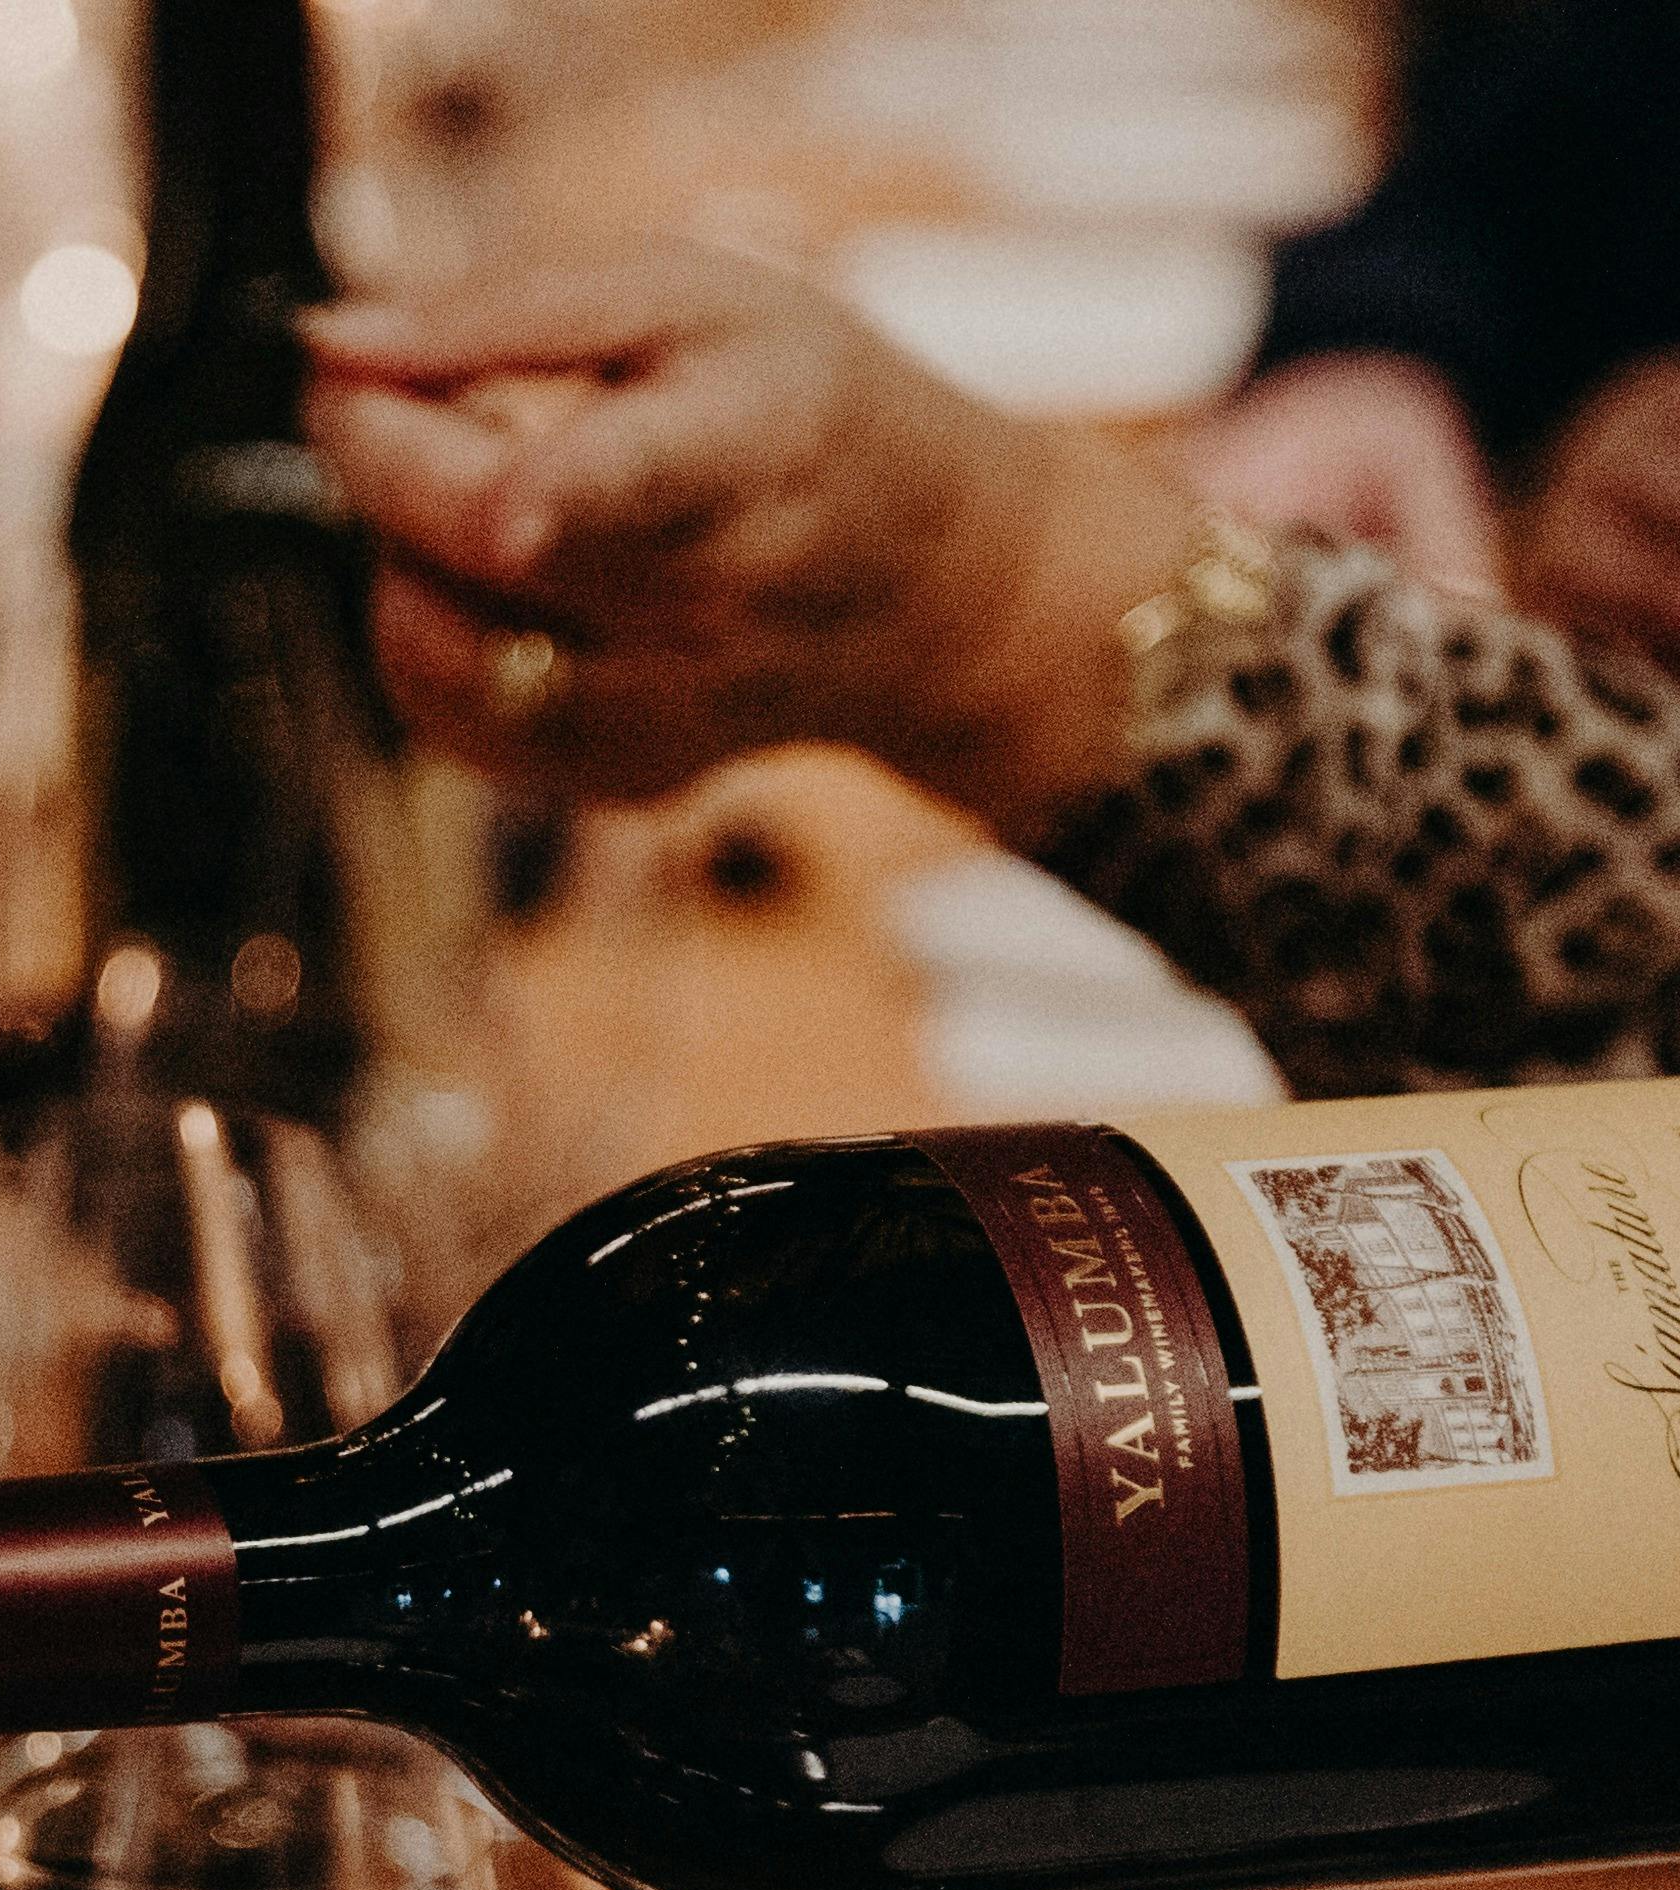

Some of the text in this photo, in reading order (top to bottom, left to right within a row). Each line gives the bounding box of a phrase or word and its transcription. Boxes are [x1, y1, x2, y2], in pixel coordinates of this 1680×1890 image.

[1115, 1227, 1176, 1370] WINEMAKERS
[1608, 1259, 1630, 1295] THE
[1009, 1163, 1165, 1527] YALUMBA
[1163, 1380, 1195, 1469] FAMILY
